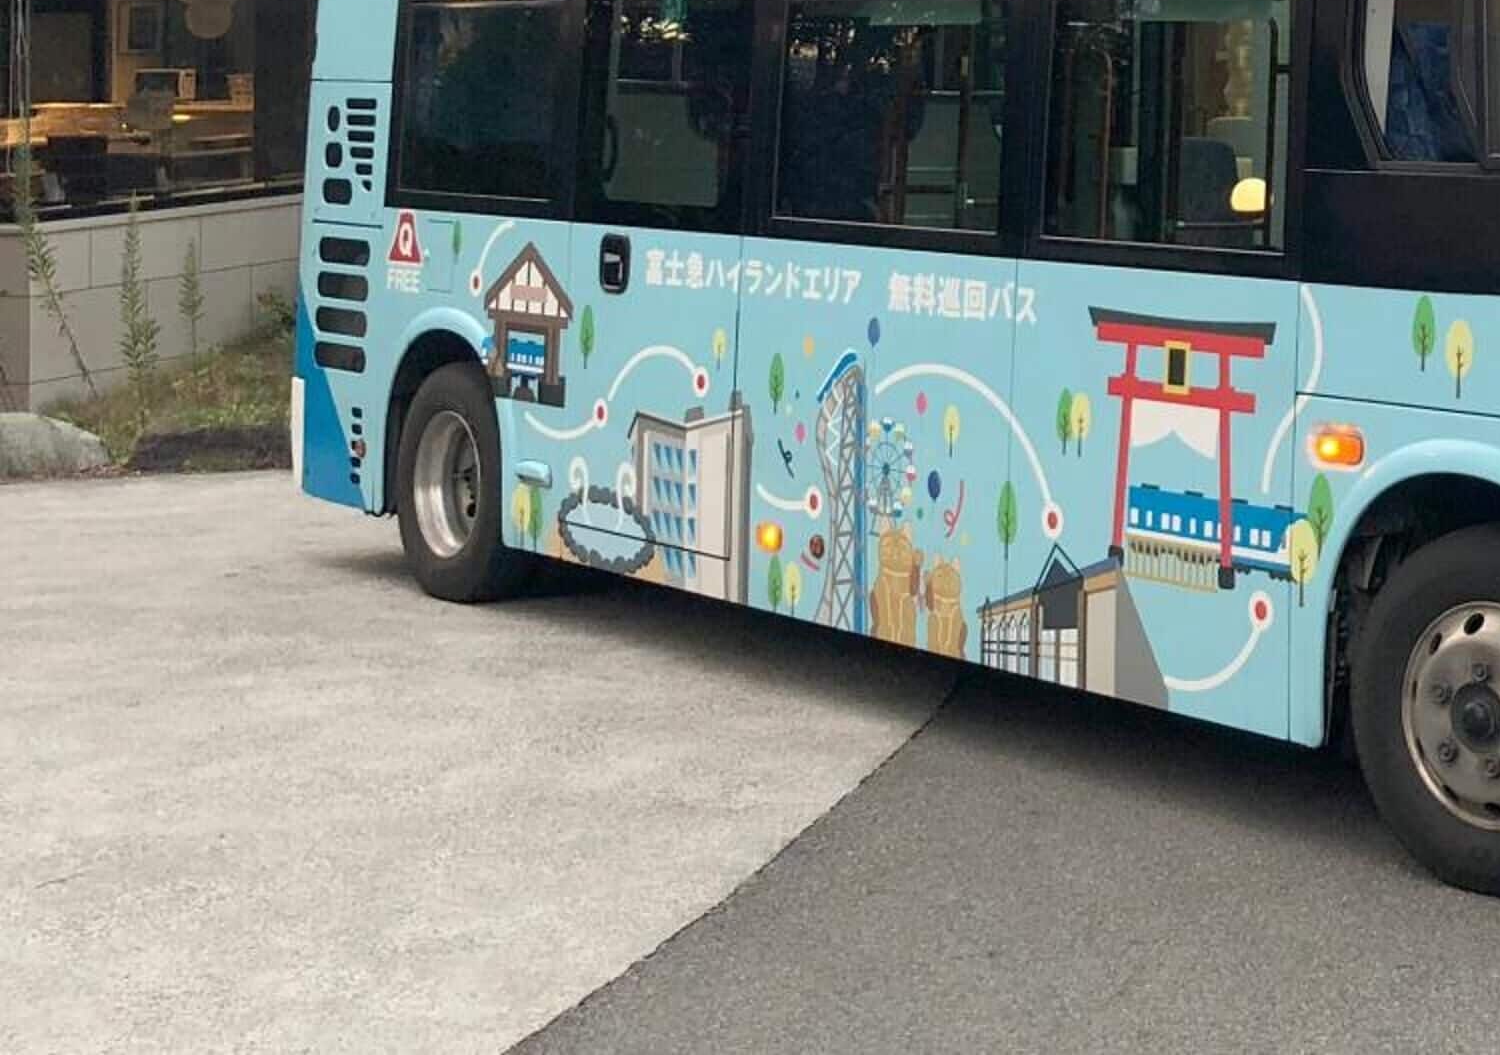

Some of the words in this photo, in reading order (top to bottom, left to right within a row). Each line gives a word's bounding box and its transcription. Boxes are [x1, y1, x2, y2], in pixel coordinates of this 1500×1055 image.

[399, 222, 414, 258] Q
[386, 267, 421, 293] FREE
[644, 247, 861, 305] 富士急ハイランドエリア
[887, 271, 1038, 324] 無料巡回バス
